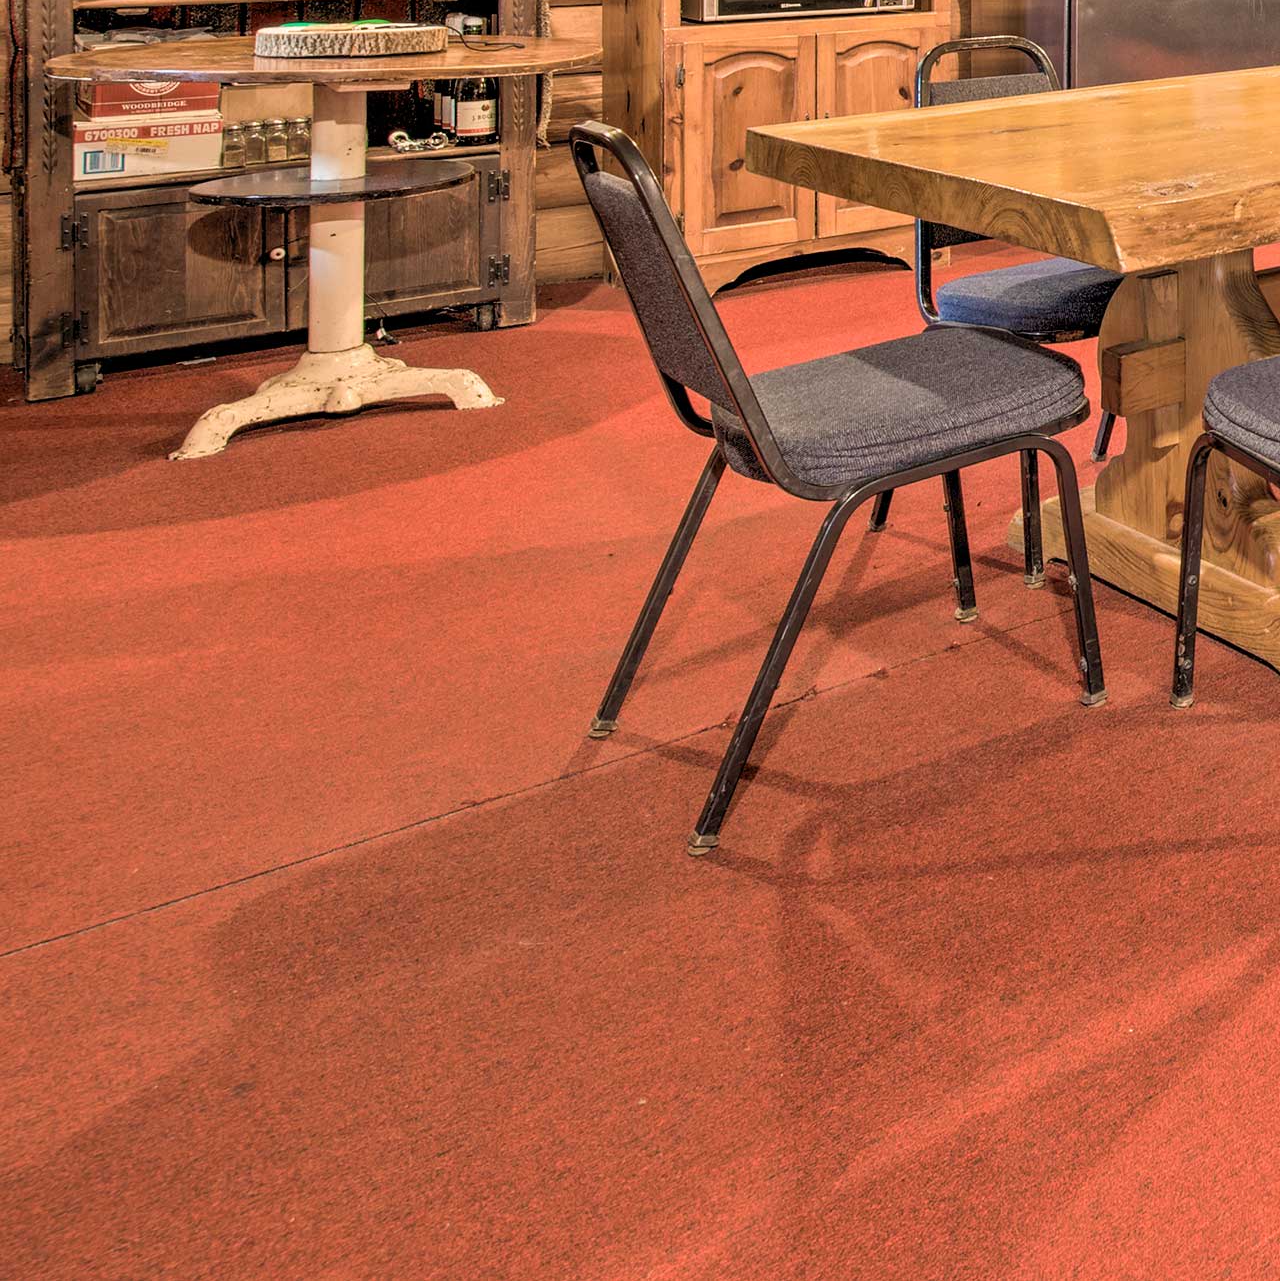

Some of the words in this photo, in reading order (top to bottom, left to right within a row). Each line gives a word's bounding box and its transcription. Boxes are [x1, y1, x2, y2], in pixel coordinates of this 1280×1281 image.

[84, 128, 138, 142] 6700300
[150, 124, 190, 137] FRESH
[193, 122, 220, 134] NAP
